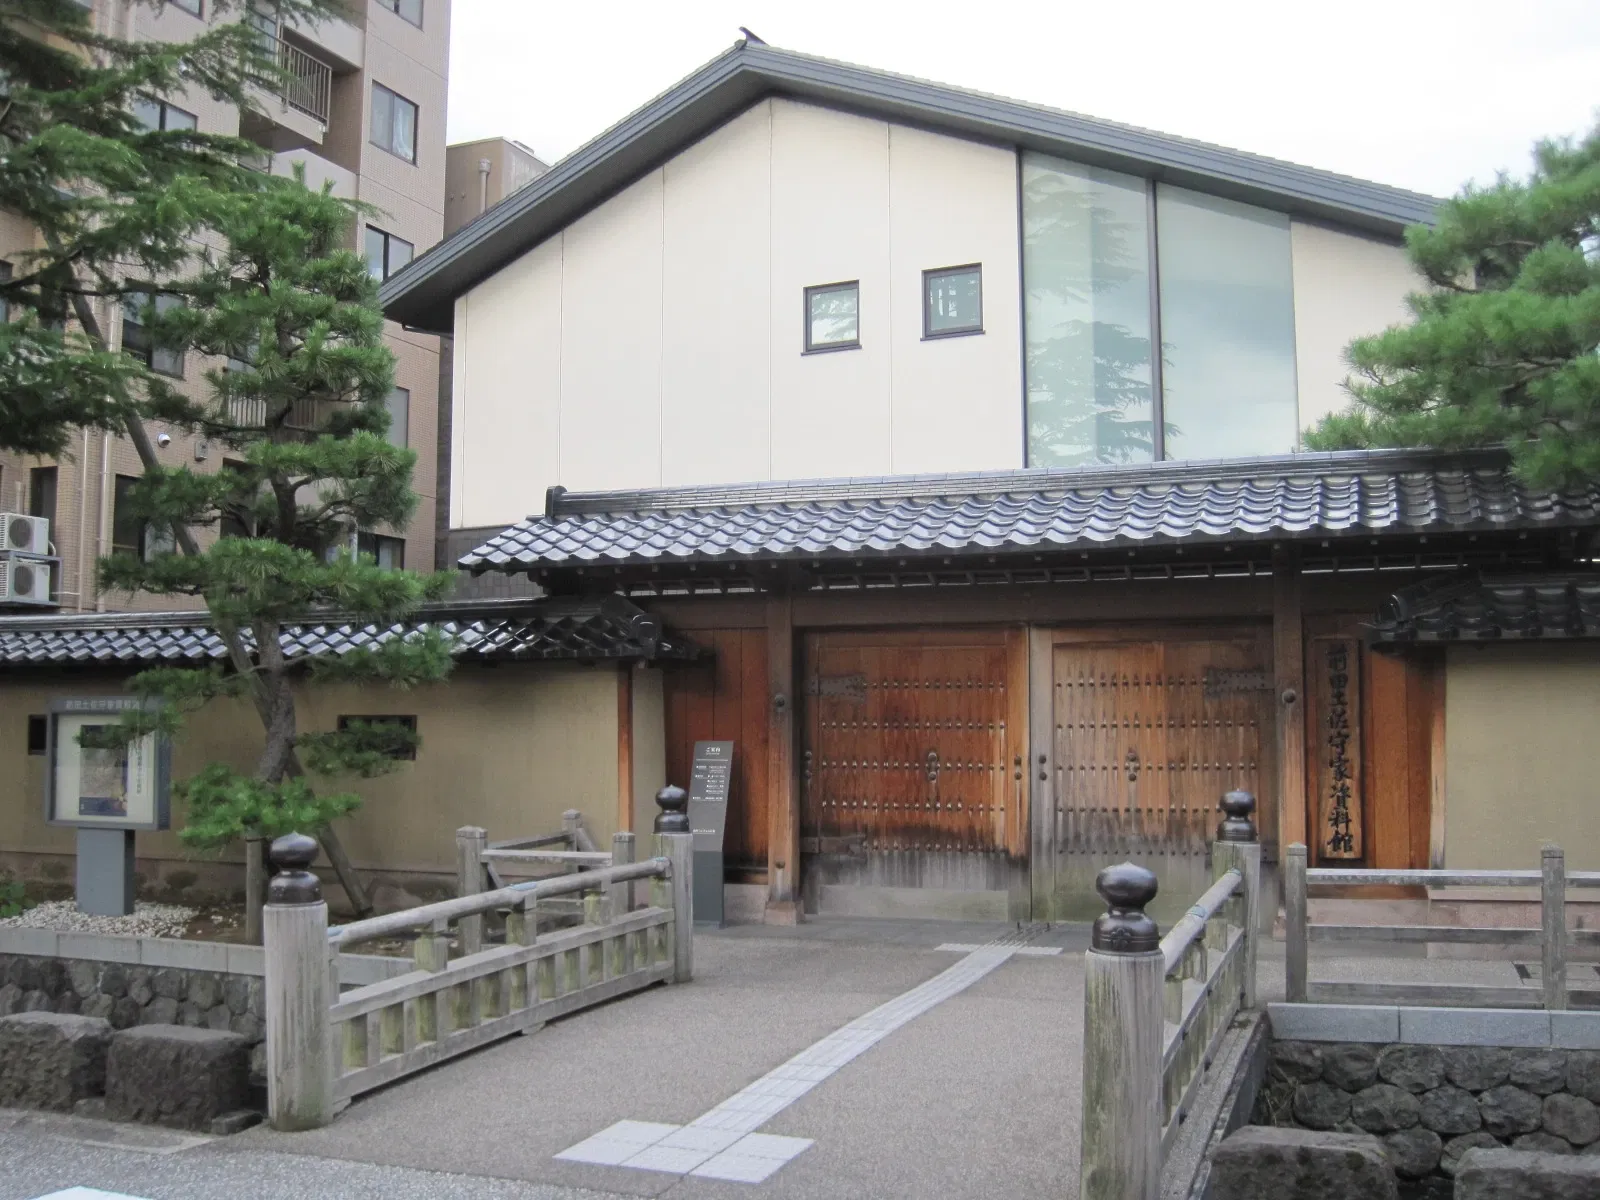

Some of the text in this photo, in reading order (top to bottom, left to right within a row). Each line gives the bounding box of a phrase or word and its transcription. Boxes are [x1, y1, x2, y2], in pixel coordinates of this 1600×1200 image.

[1326, 643, 1354, 852] 前田土佐守家資料館
